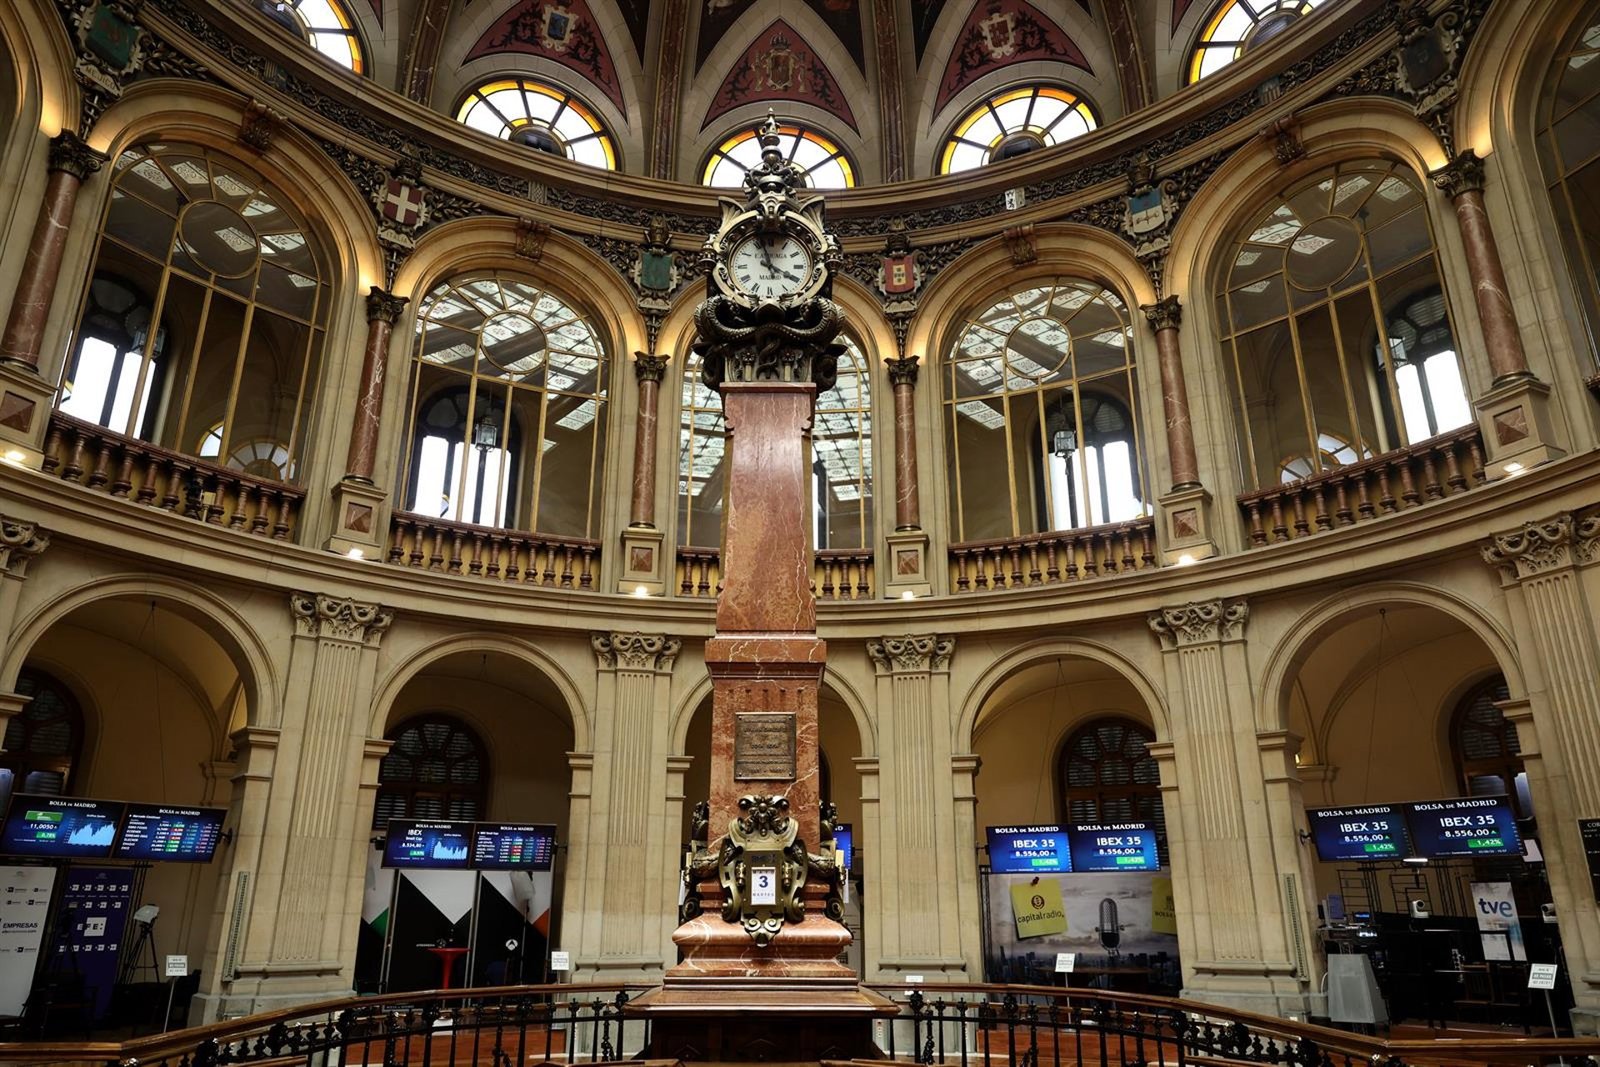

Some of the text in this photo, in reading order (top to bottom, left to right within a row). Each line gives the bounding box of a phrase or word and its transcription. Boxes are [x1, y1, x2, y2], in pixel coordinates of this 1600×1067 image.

[1414, 803, 1444, 811] BOLSA
[1456, 799, 1498, 808] MADRID
[1317, 810, 1344, 818] BOLSA
[1354, 806, 1391, 815] MADRID
[1340, 821, 1389, 833] IBEX 35
[1440, 815, 1495, 828] IBEX 35
[1344, 834, 1384, 842] 8.556,00
[1445, 828, 1490, 838] 8.556,00
[1013, 839, 1056, 848] IBEX 35
[1096, 836, 1141, 846] IBEX 35
[1099, 848, 1136, 856] 8.556,00
[759, 875, 769, 888] 3
[1478, 897, 1513, 916] tve
